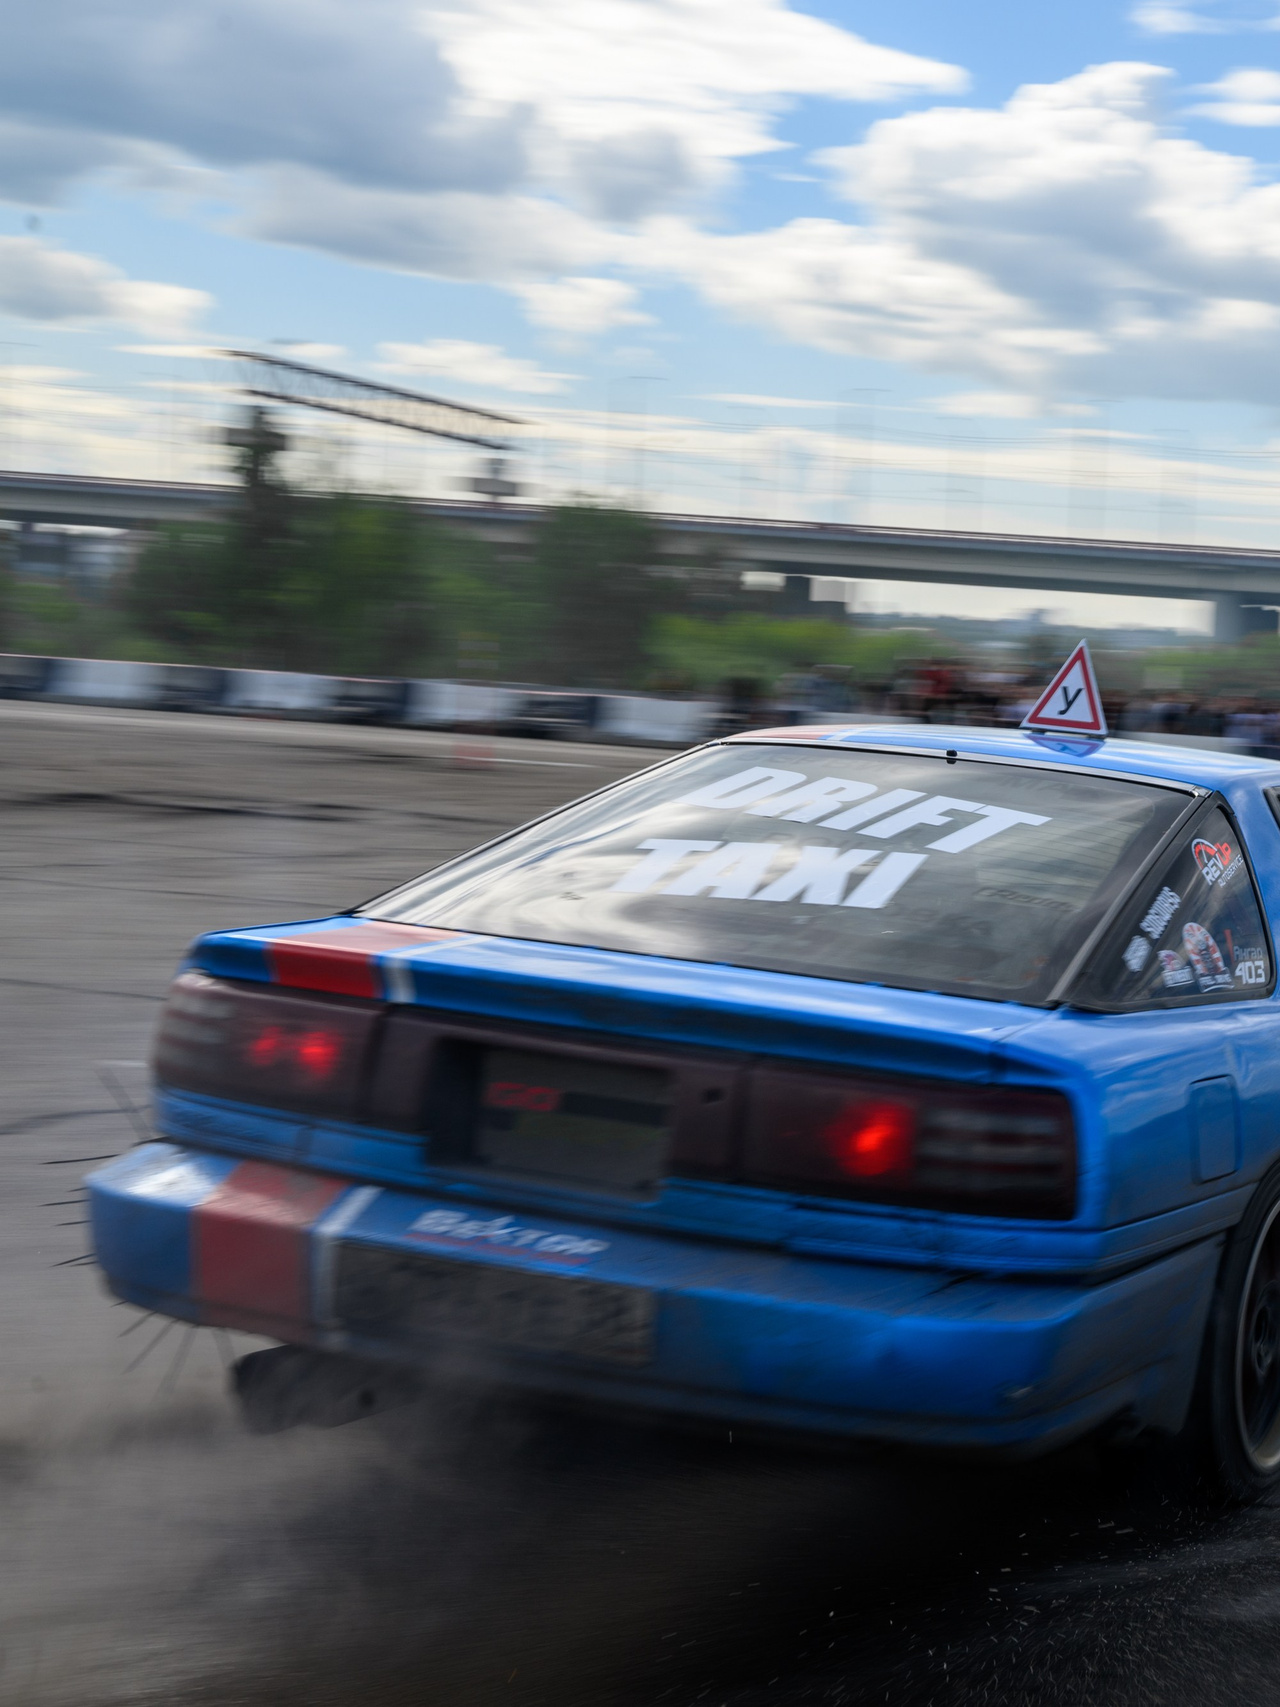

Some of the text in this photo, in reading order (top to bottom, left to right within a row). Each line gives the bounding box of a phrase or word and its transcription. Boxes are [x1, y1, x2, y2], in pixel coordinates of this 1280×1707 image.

[672, 766, 1053, 854] DRIFT
[610, 838, 930, 909] TAXI
[1234, 960, 1266, 985] 403
